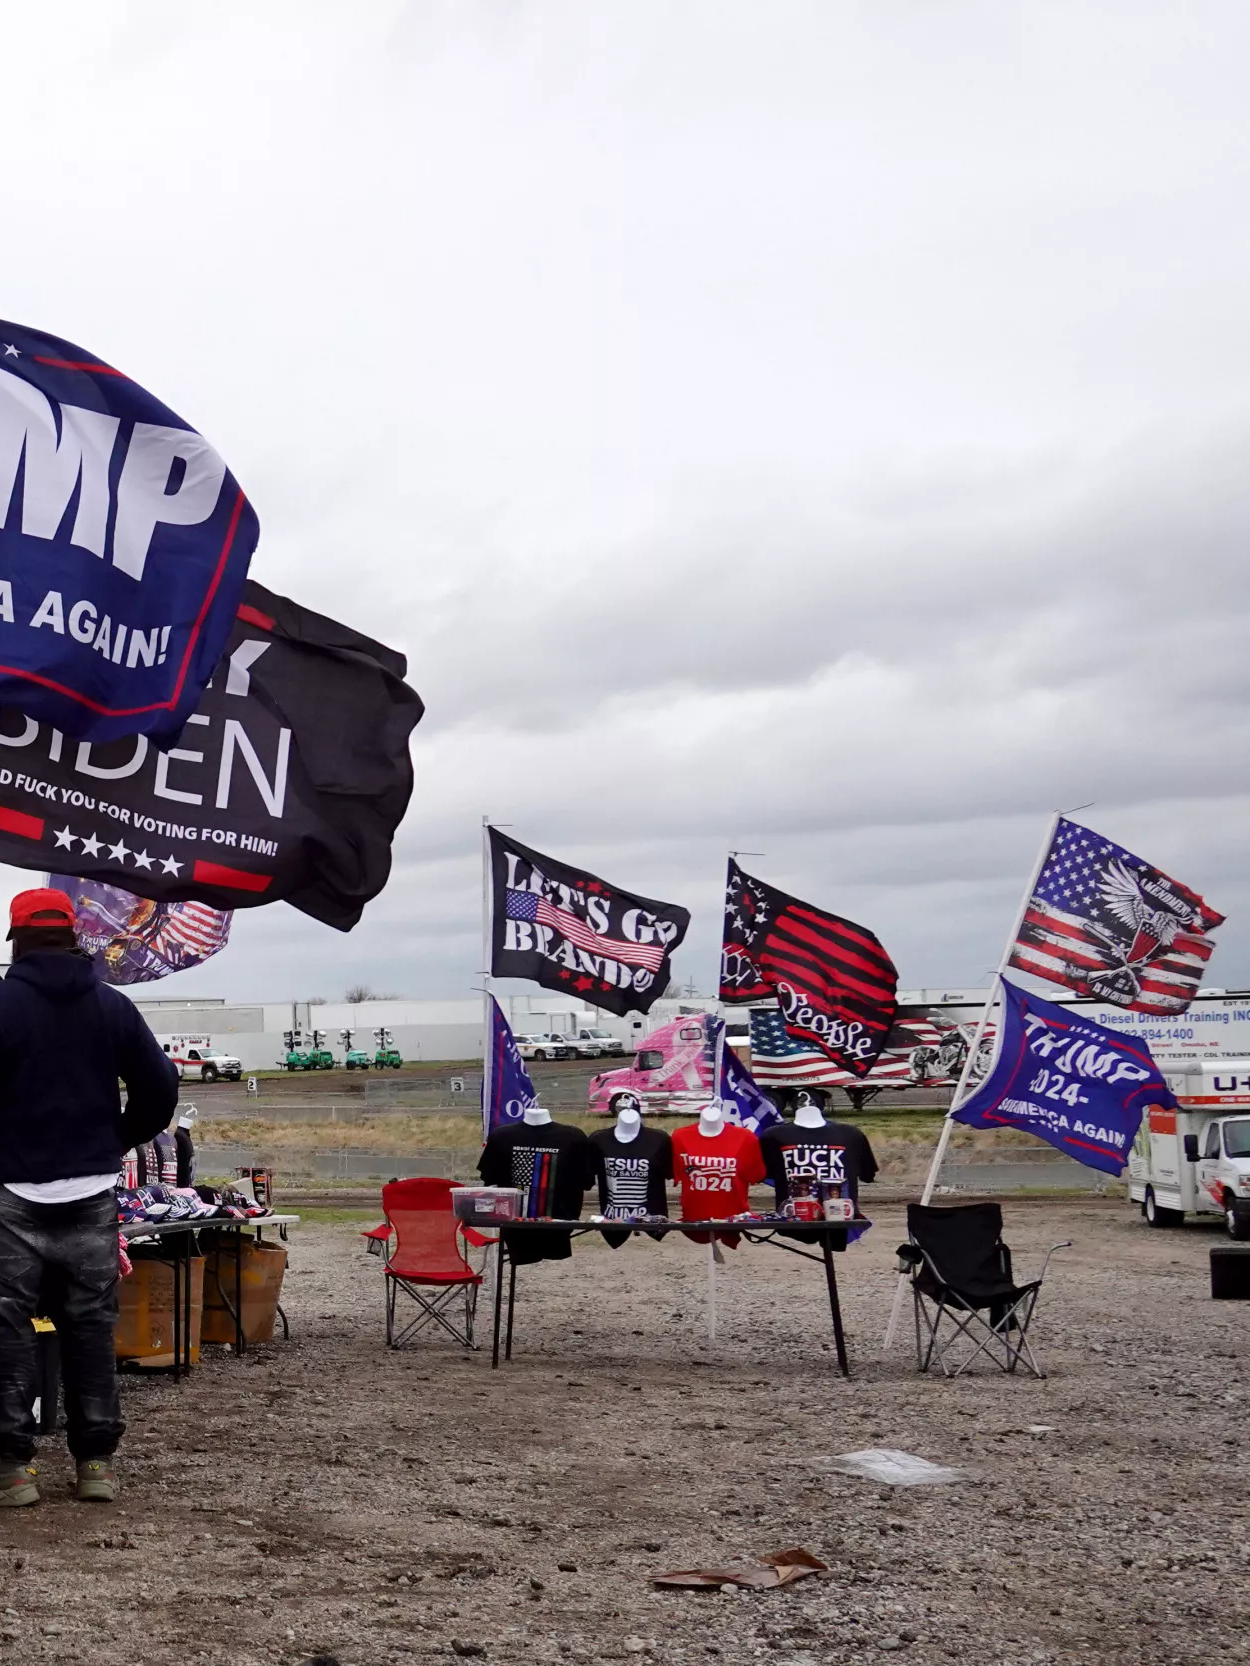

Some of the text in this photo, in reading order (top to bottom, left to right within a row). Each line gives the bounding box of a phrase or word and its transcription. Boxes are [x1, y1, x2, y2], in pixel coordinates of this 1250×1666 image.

[30, 590, 172, 669] AGAIN!
[14, 774, 59, 801] FUCK
[61, 788, 96, 811] YOU
[98, 801, 131, 825] FOR
[133, 815, 198, 841] VOTING
[201, 827, 237, 847] FOR
[240, 834, 279, 857] HIM!
[502, 918, 656, 993] BRANDO
[776, 981, 877, 1061] People
[1100, 1012, 1135, 1024] Diesel
[1138, 1012, 1179, 1024] Drivers
[1183, 1010, 1229, 1024] Training
[1120, 1028, 1194, 1040] 2-894-1400
[1023, 1012, 1151, 1084] TRUMP
[248, 1081, 254, 1089] 2
[454, 1082, 462, 1091] 3
[679, 1153, 738, 1171] Trump
[781, 1148, 846, 1168] FUCK
